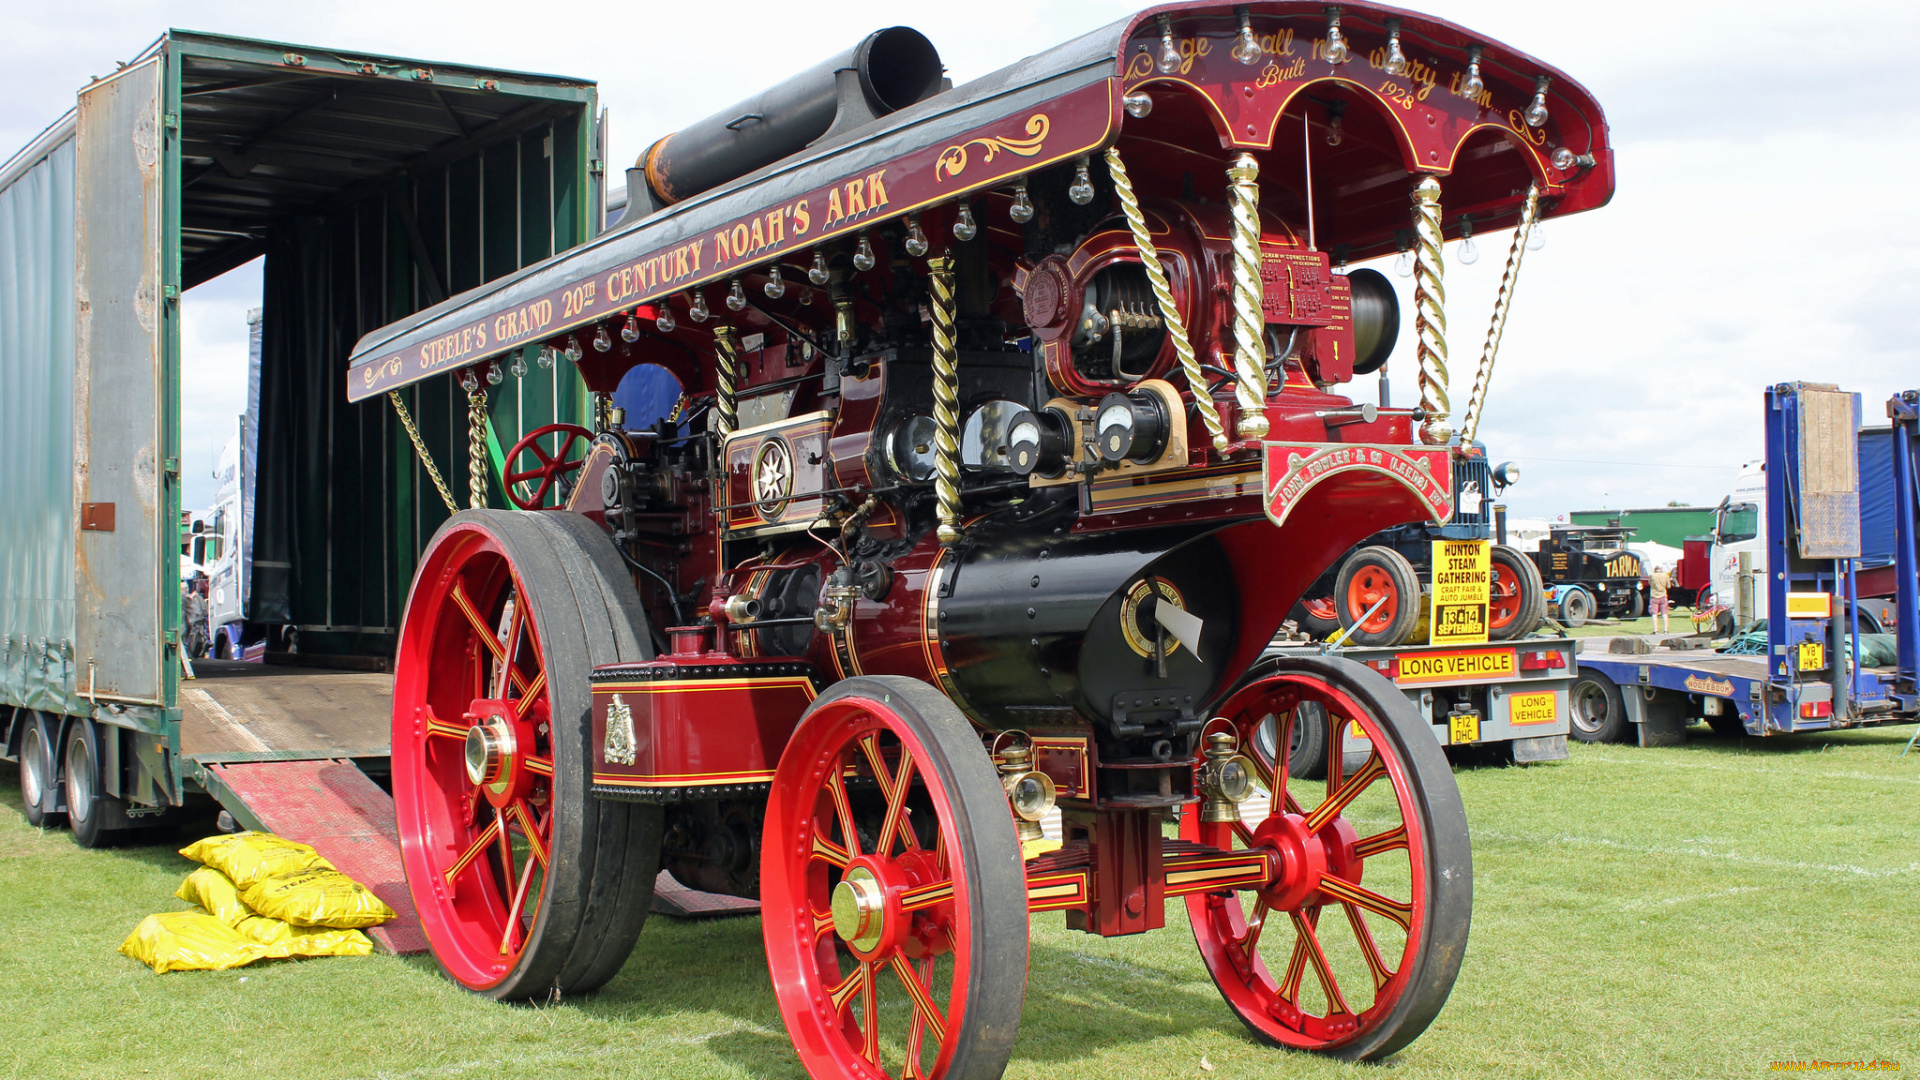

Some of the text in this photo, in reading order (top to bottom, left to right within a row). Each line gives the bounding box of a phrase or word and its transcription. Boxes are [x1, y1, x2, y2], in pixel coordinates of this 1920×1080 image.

[1256, 56, 1415, 111] Built 1928
[420, 169, 889, 369] STEELE'S GRAND 20TH CENTURY NOAH'S ARK
[1279, 474, 1306, 507] JOHN
[1307, 451, 1351, 478] FOWLER
[1355, 448, 1366, 463] &
[1444, 544, 1480, 557] HUNTON
[1448, 558, 1477, 570] STEAM
[1604, 554, 1642, 578] TARMA
[1437, 571, 1487, 584] GATHERING
[1441, 586, 1461, 594] CRAFT
[1440, 593, 1483, 602] AUTO JUMBLE
[1445, 611, 1457, 625] 13
[1466, 611, 1476, 624] 14
[1437, 623, 1483, 635] SEPTEMBER
[1806, 646, 1816, 656] V8
[1401, 655, 1509, 675] LONG VEHICLE
[1688, 680, 1731, 694] NOOTEBOOM
[1521, 697, 1546, 707] LONG
[1515, 708, 1553, 720] VEHICLE
[1456, 717, 1471, 728] F12
[1455, 729, 1473, 742] DHC
